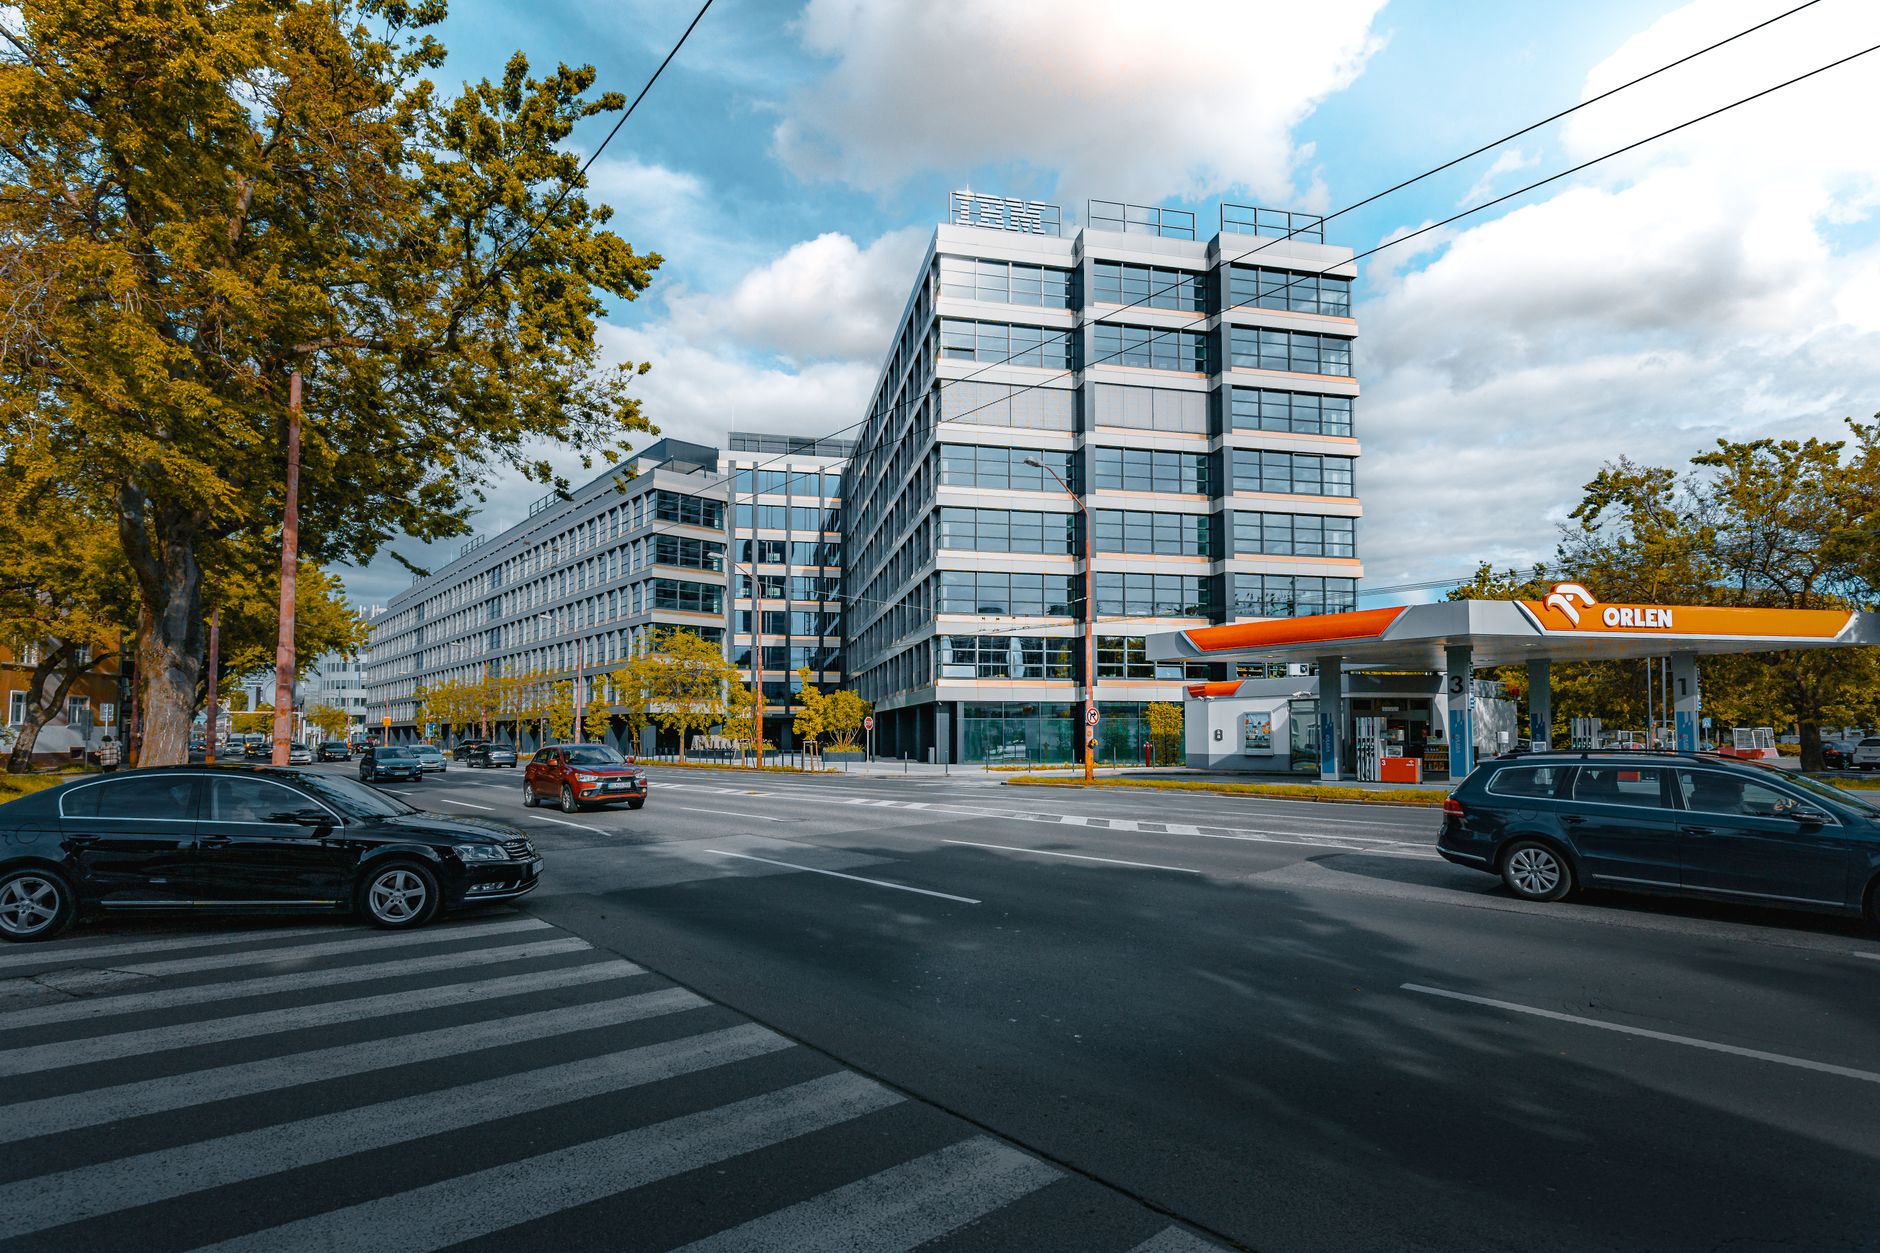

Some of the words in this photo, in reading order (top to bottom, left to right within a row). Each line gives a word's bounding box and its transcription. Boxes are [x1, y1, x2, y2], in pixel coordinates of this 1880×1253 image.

[955, 190, 1046, 234] IBM
[1603, 607, 1673, 628] ORLEN
[1450, 675, 1464, 694] 3
[1678, 678, 1687, 695] 1
